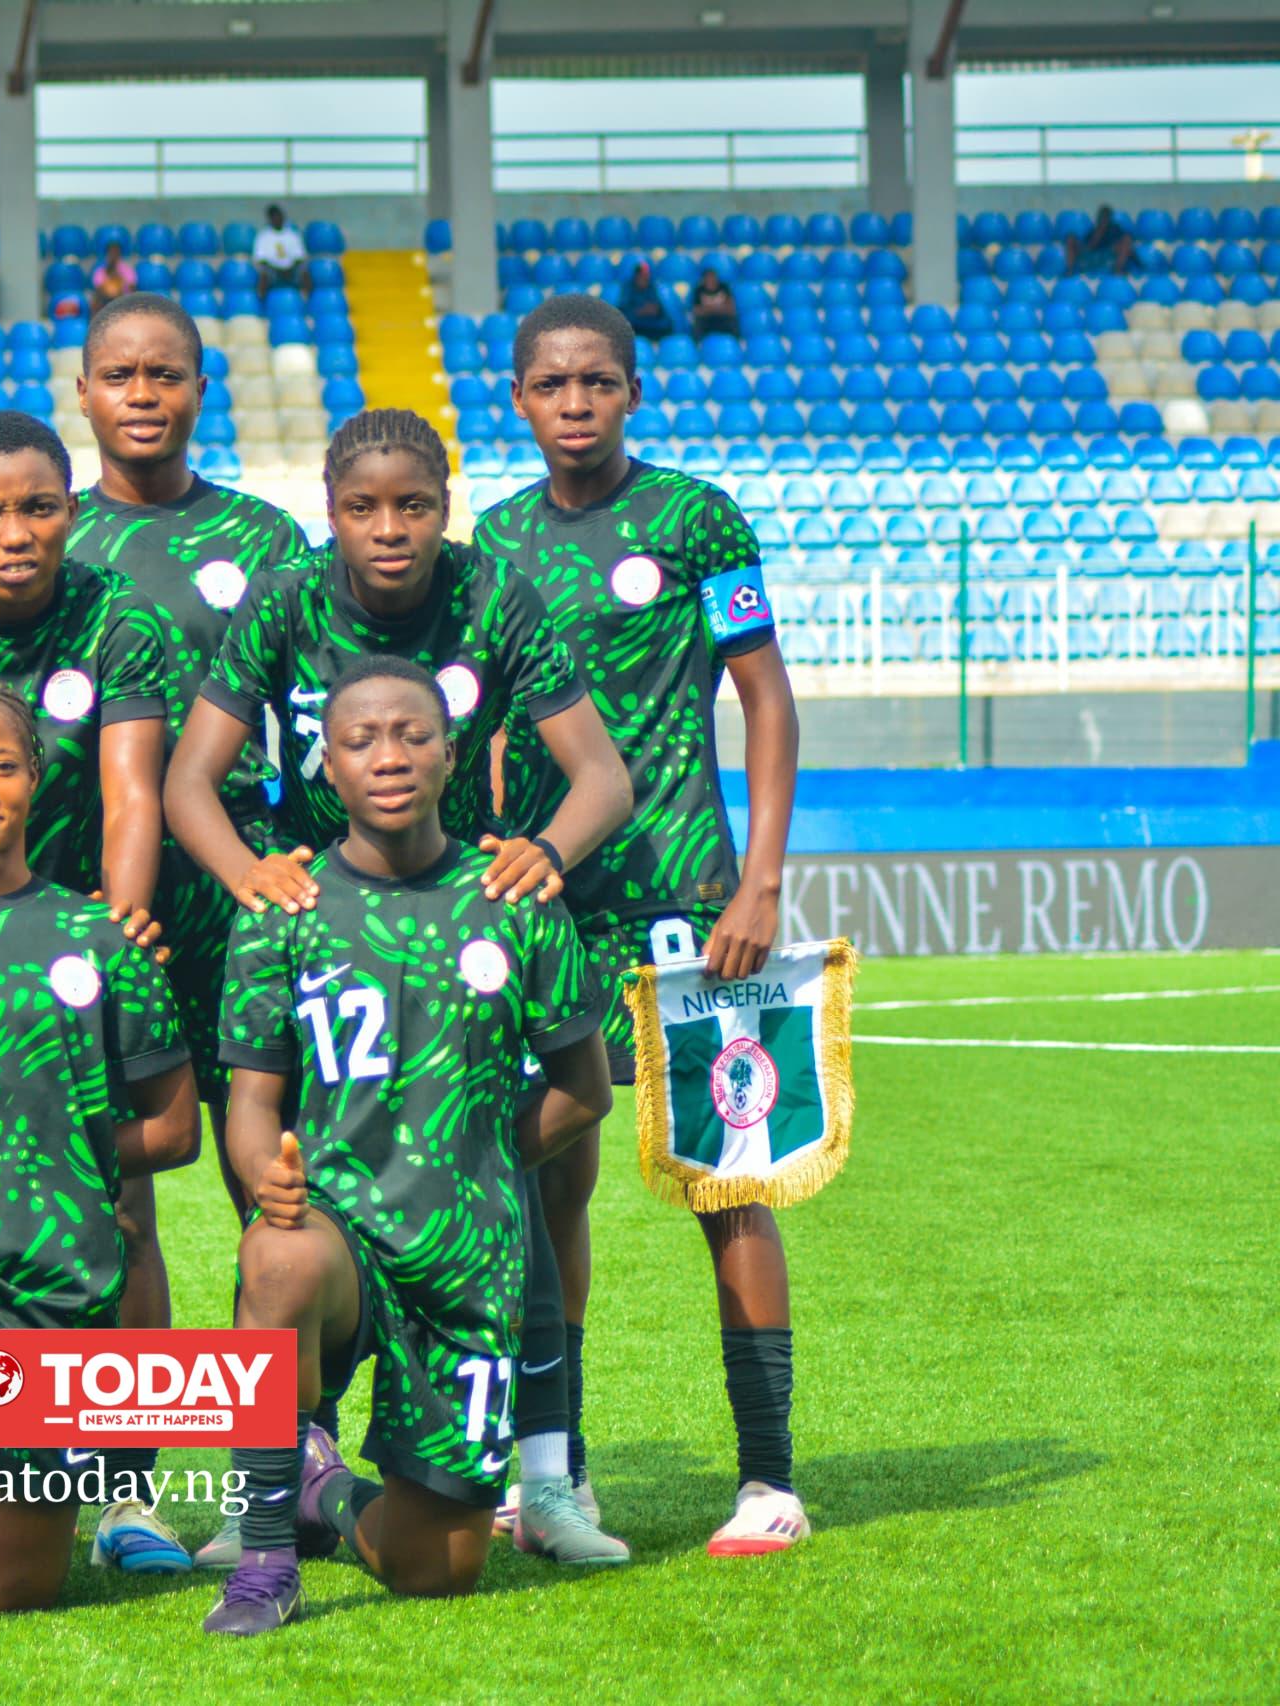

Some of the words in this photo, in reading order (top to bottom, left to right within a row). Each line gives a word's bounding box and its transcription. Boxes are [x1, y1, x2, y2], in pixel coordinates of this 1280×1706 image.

[1016, 856, 1209, 953] REMO
[296, 988, 389, 1083] 12
[682, 982, 788, 1017] NIGERIA
